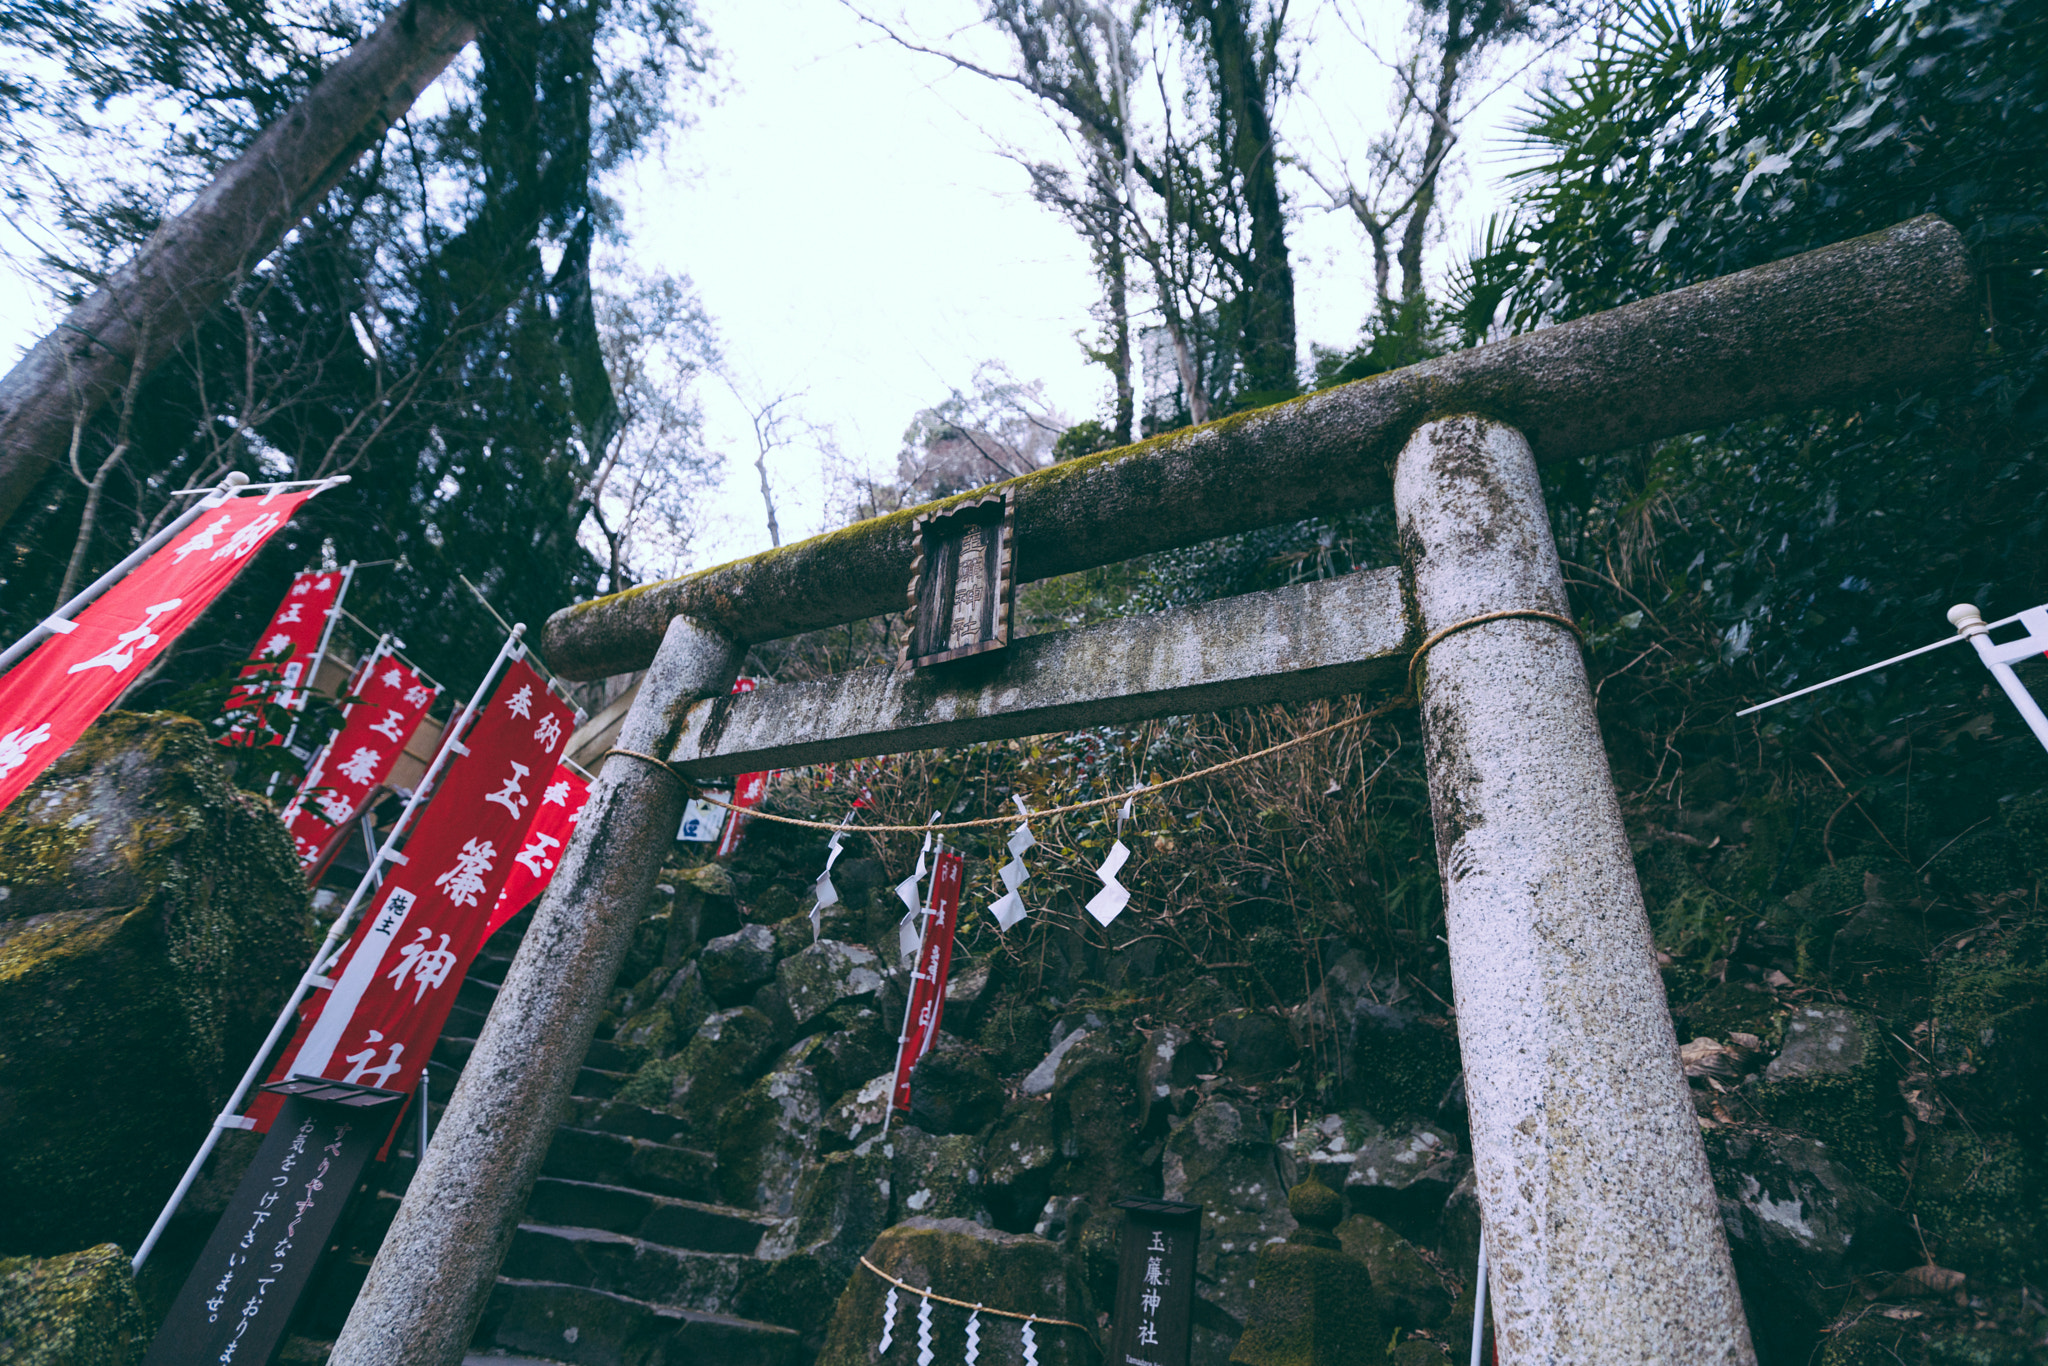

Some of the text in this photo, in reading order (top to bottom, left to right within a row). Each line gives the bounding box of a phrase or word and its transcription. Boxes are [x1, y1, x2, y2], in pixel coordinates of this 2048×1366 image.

[504, 683, 562, 754] 奉納
[343, 760, 531, 1089] 玉簾神社
[219, 1122, 353, 1366] すべりやすくなっておりま
[1137, 1231, 1166, 1347] 玉簾神社
